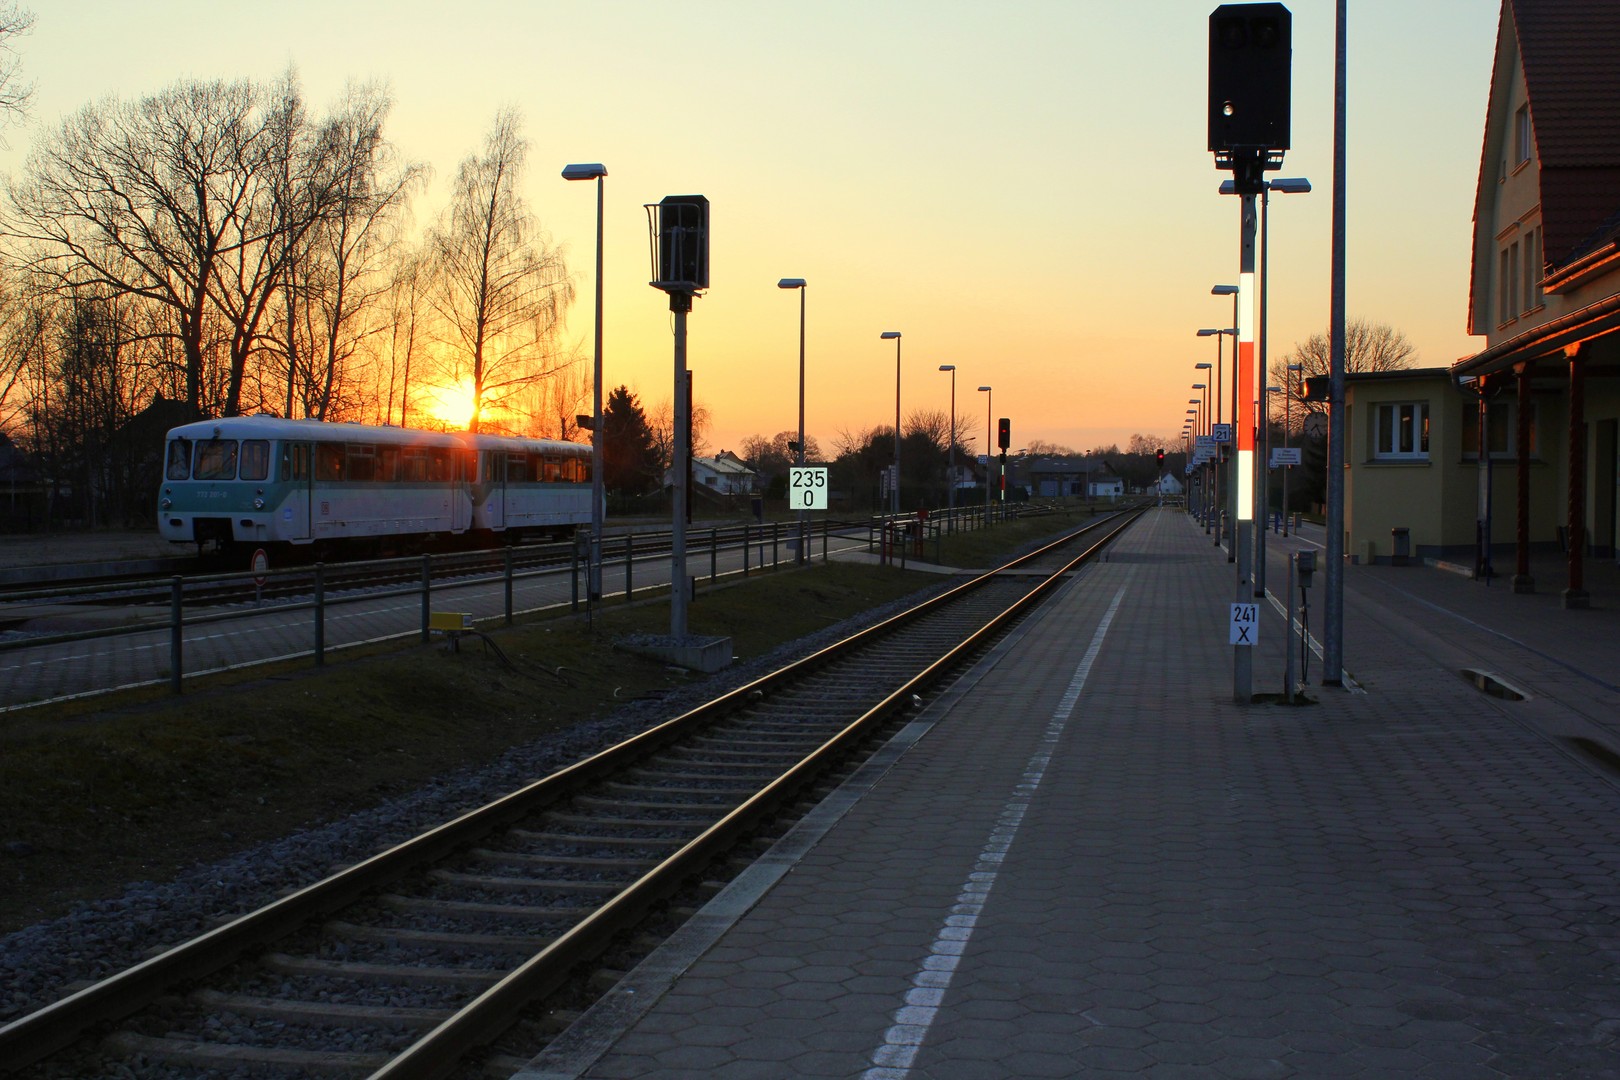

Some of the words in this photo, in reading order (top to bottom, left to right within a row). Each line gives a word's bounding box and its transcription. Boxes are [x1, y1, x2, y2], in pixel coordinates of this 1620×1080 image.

[1216, 430, 1227, 439] 21
[793, 471, 825, 487] 235
[804, 490, 813, 507] 0
[1234, 606, 1256, 622] 241
[1239, 626, 1250, 642] X
